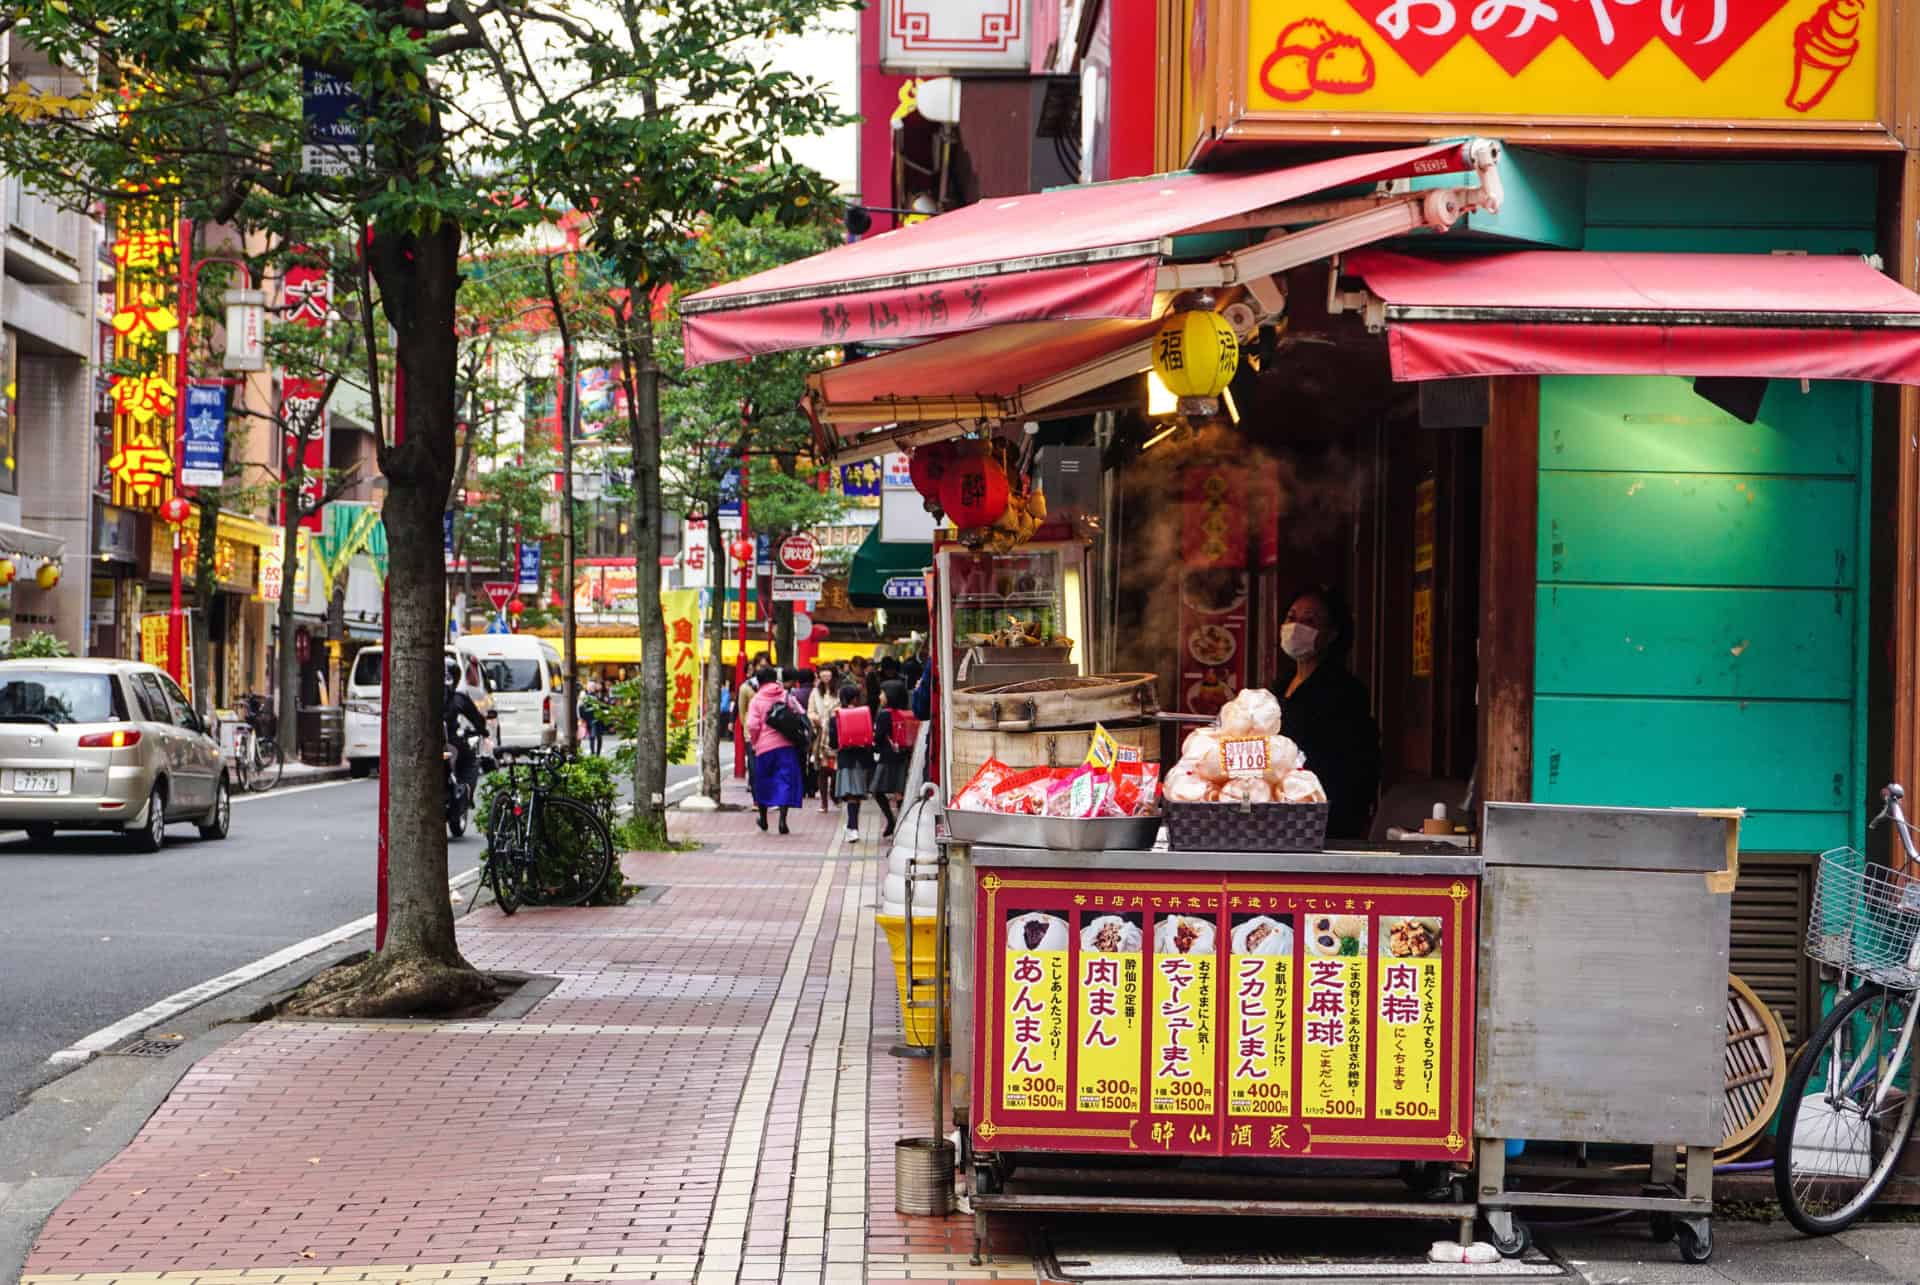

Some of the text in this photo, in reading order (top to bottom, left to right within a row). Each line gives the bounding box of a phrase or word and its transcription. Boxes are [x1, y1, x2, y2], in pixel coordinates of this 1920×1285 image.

[1160, 330, 1184, 373] 福
[1011, 955, 1044, 1073] あんまん
[1083, 958, 1119, 1046] 肉まん
[1306, 960, 1345, 1046] 芝麻球
[1381, 963, 1420, 1024] 肉粽
[1159, 958, 1194, 1078] チャーシューまん
[1236, 959, 1267, 1078] フカヒレまん
[1392, 1027, 1407, 1091] にくちまき
[1022, 1078, 1064, 1093] 300円
[1096, 1079, 1138, 1095] 300円
[1170, 1081, 1211, 1097] 300円
[1247, 1083, 1289, 1098] 400円
[1325, 1100, 1362, 1116] 500円
[1395, 1102, 1437, 1117] 500円
[1151, 1120, 1291, 1150] 酔仙酒家
